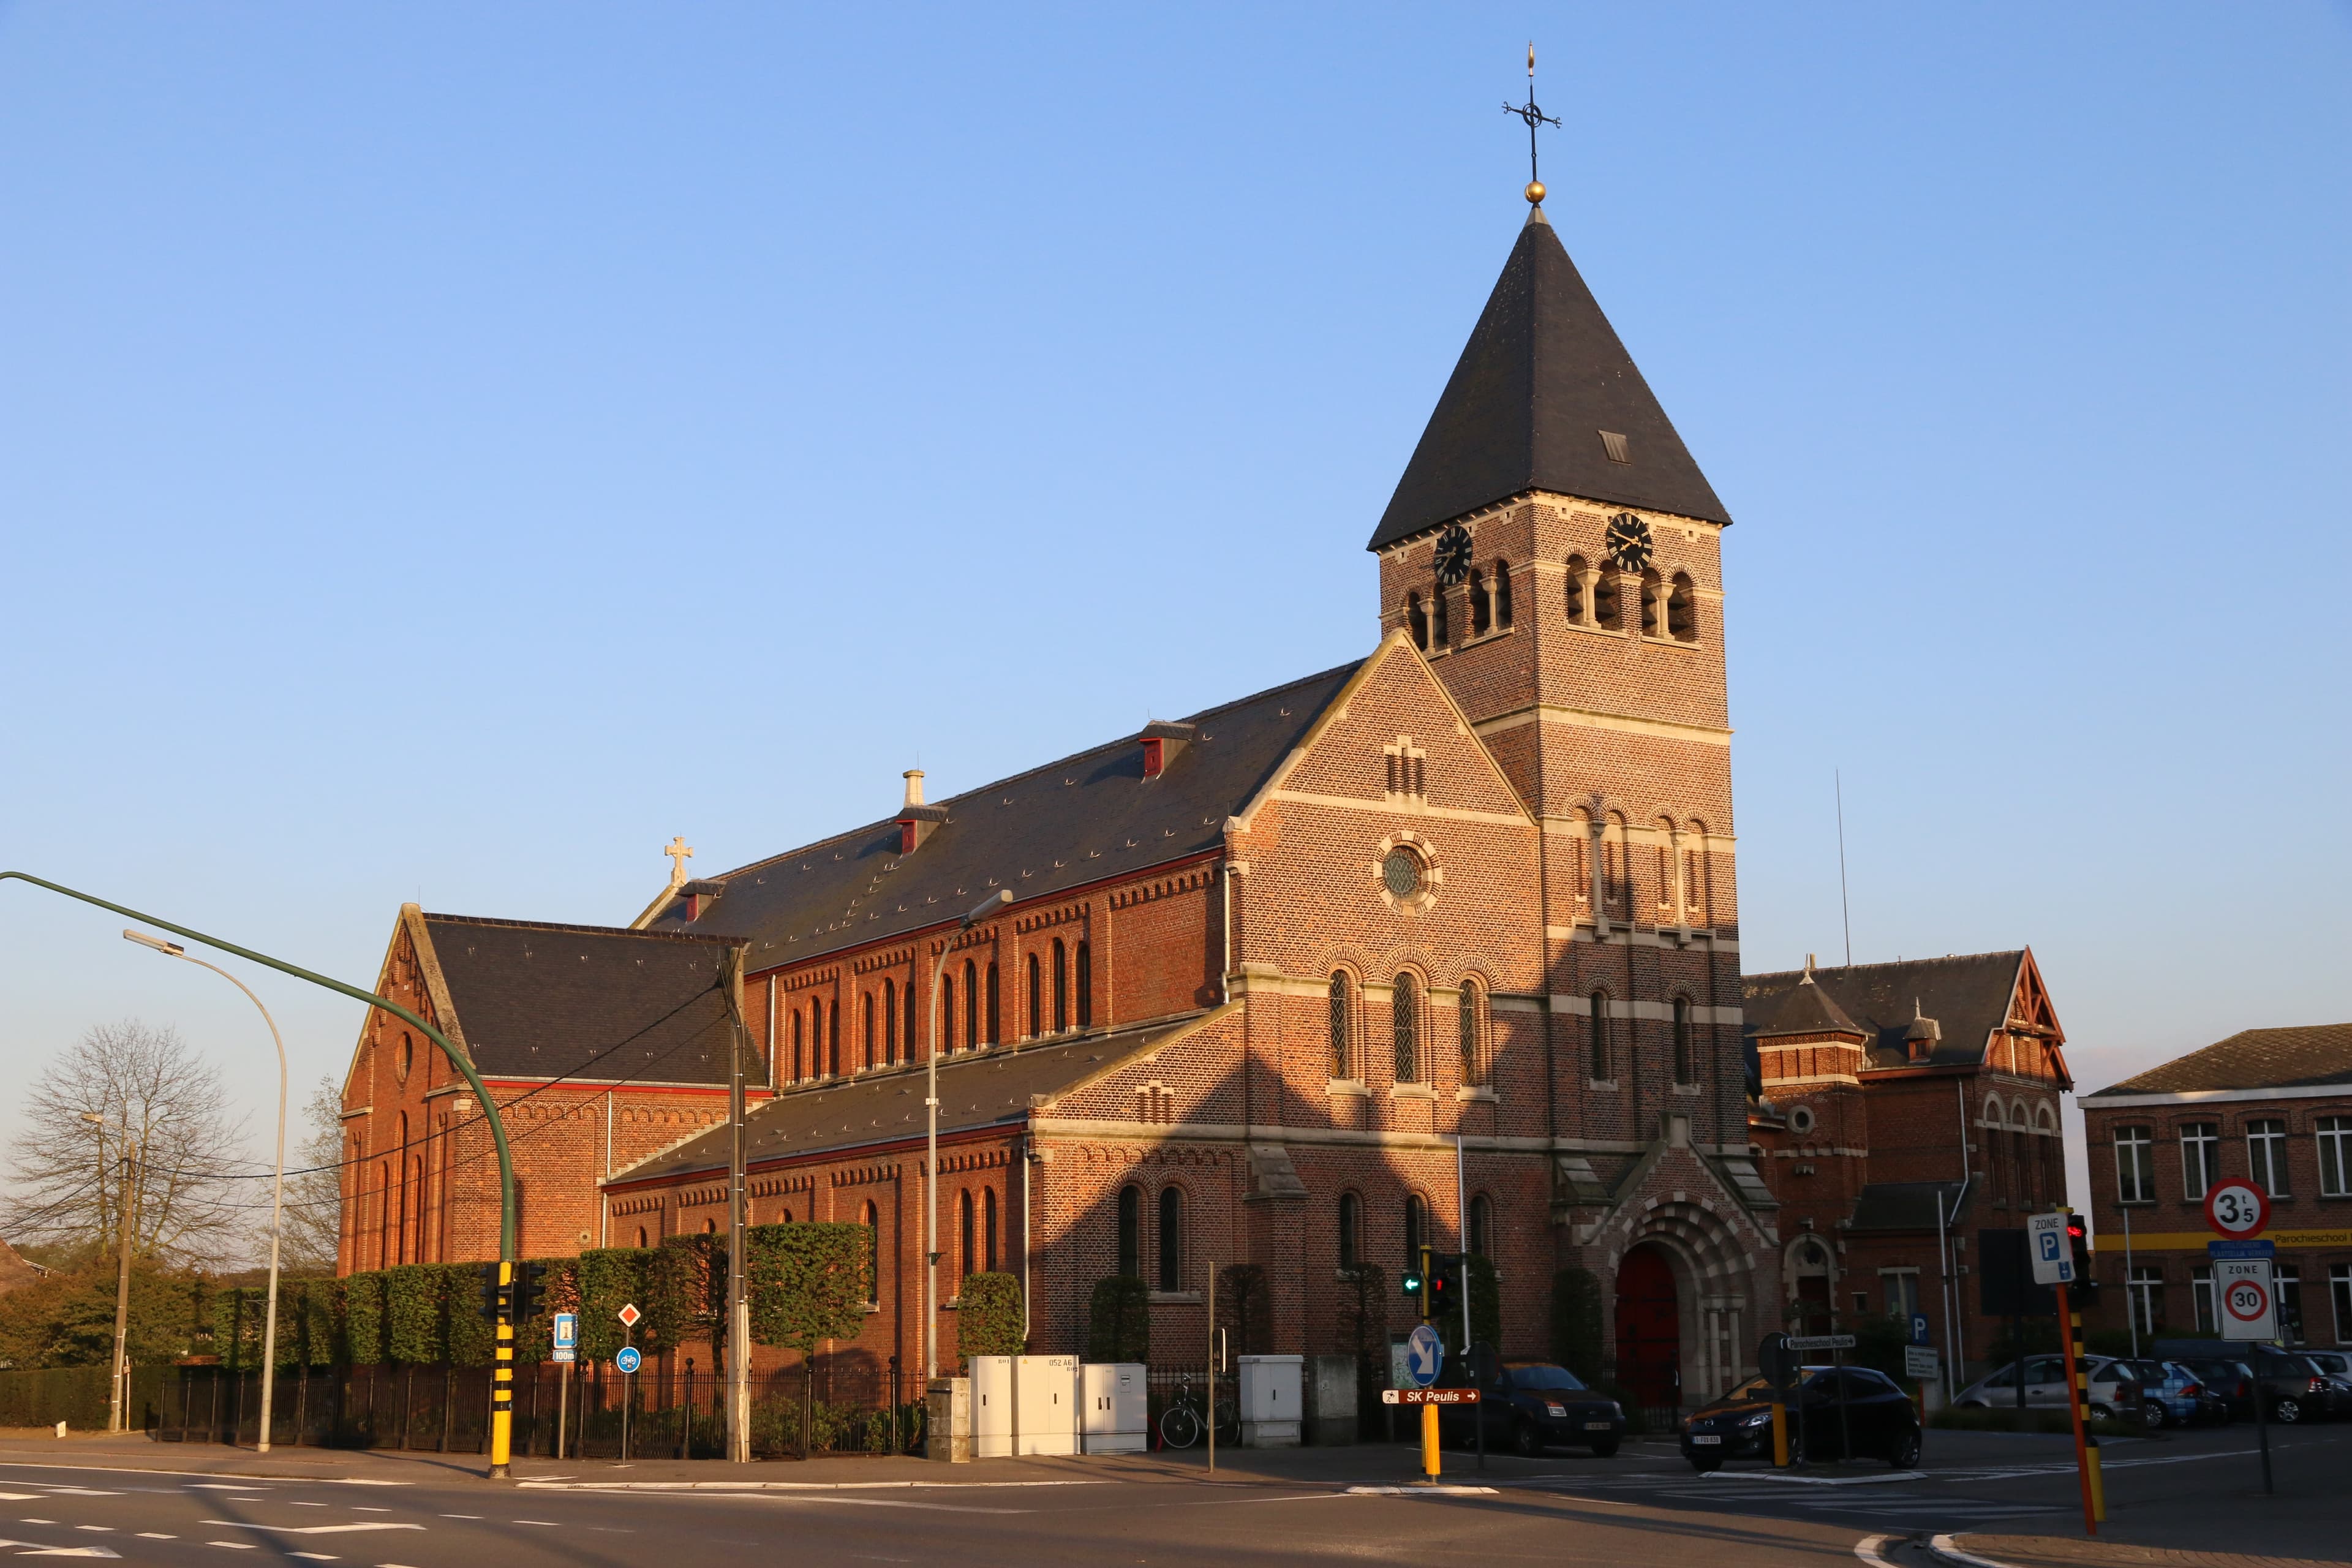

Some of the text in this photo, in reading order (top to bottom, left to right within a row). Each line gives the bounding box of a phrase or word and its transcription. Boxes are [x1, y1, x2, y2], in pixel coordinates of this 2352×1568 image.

[2242, 1194, 2247, 1204] t
[2218, 1194, 2254, 1223] 3 5
[2035, 1218, 2059, 1230] ZONE
[2275, 1233, 2347, 1243] Parochieschool
[2043, 1235, 2056, 1258] P
[2228, 1265, 2258, 1274] ZONE
[2234, 1292, 2258, 1307] 30
[1915, 1318, 1926, 1340] P
[1791, 1338, 1831, 1349] Parochieschool
[556, 1352, 575, 1360] 100m
[1407, 1391, 1459, 1402] SK Peulis
